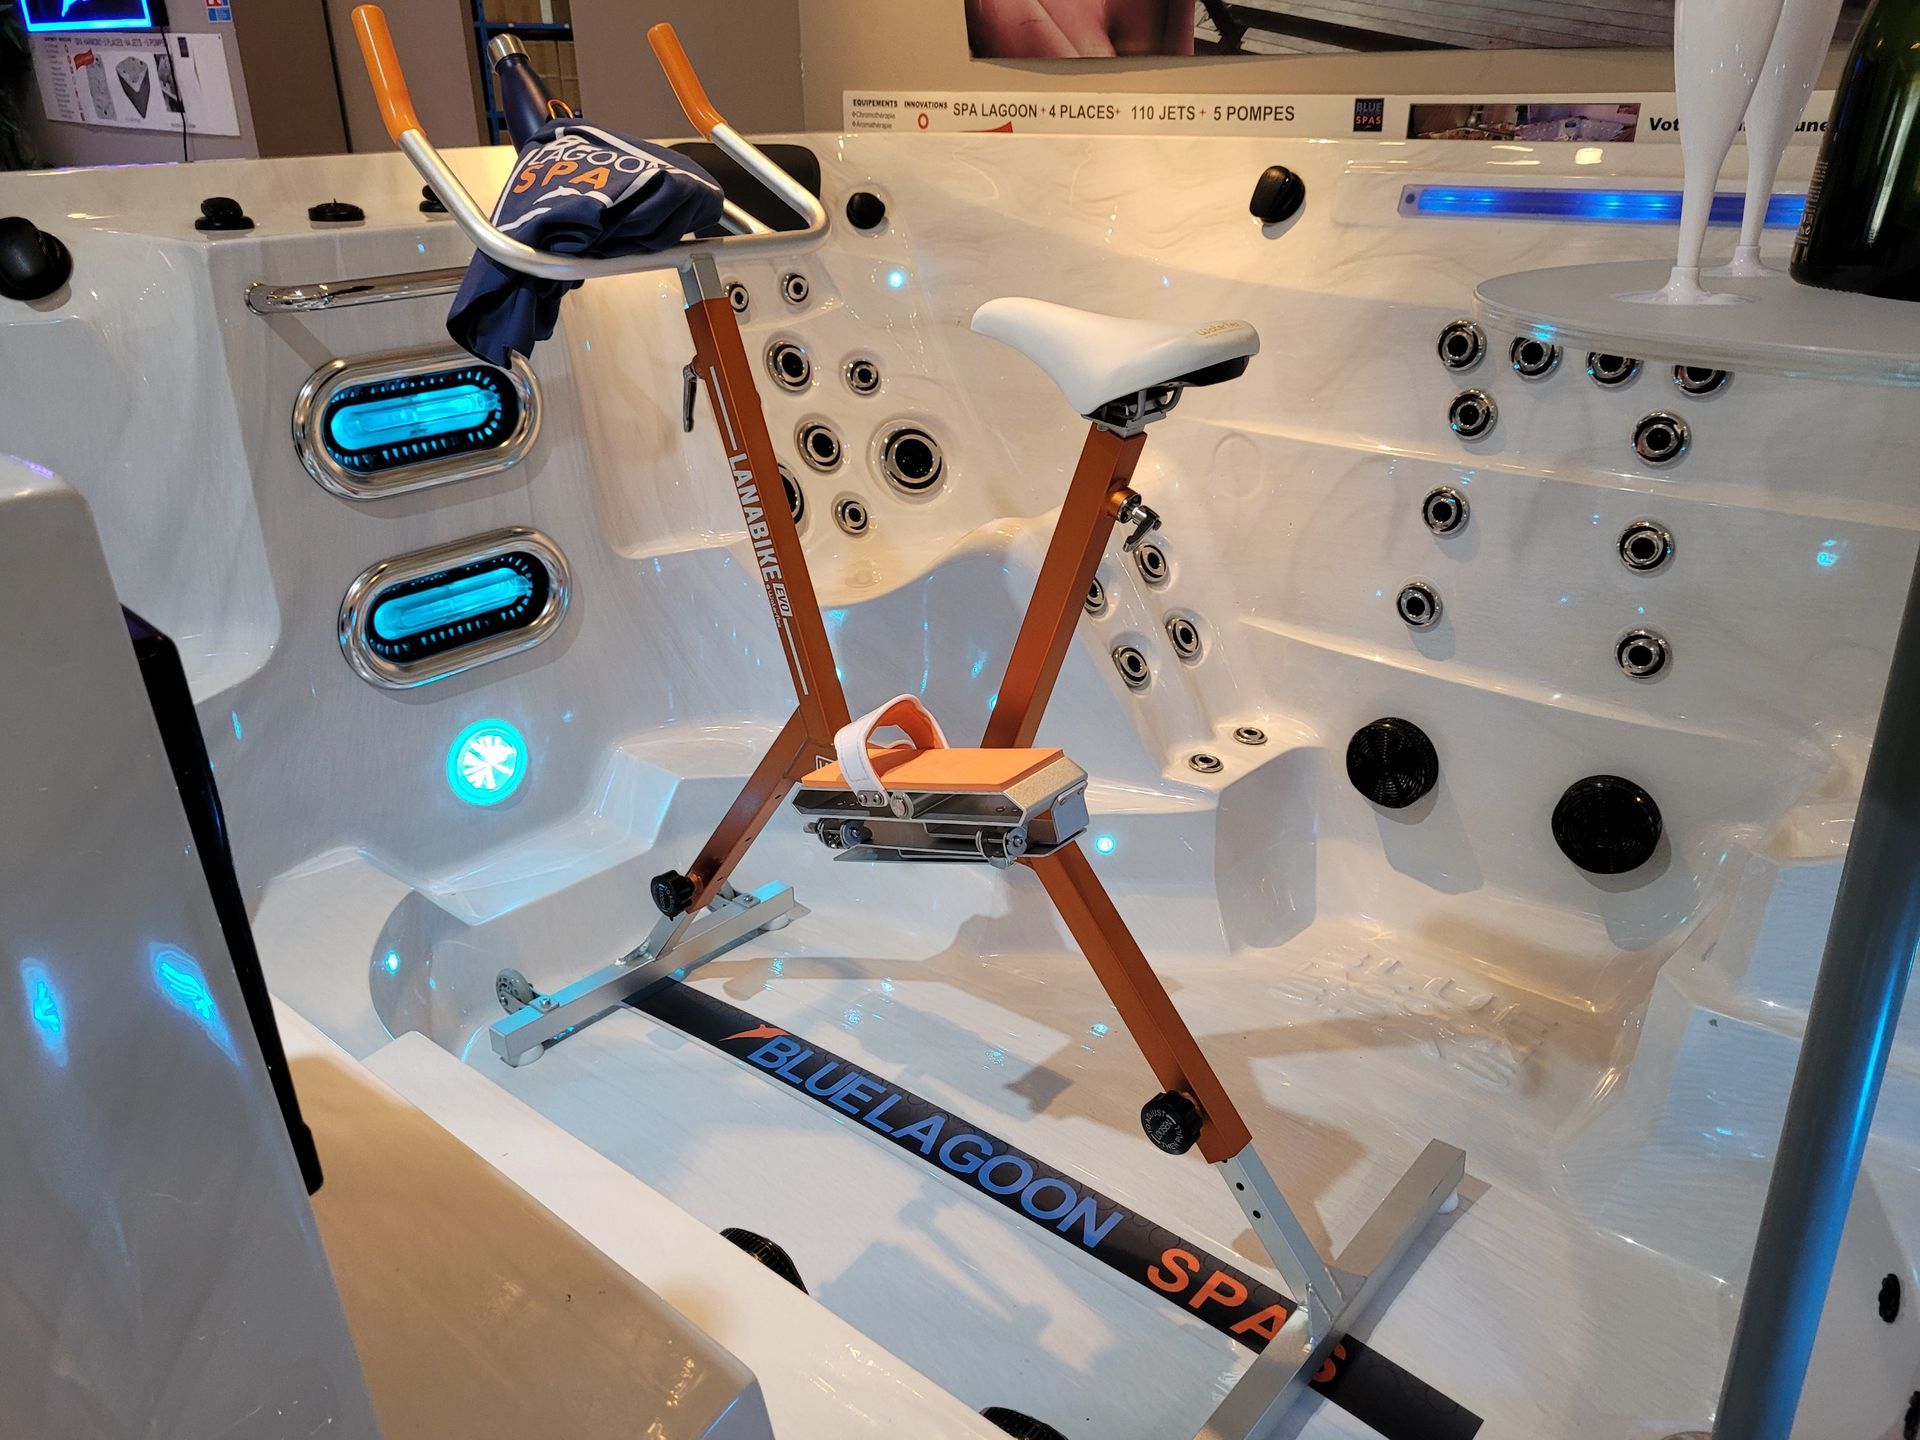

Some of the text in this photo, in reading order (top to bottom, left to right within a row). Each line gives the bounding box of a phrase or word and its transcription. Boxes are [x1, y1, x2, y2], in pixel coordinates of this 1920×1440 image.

[853, 99, 898, 108] EQUIPEMENTS
[904, 101, 948, 109] INNOVATIONS
[1356, 102, 1382, 112] BLUE
[953, 103, 978, 117] SPA
[982, 103, 1037, 118] LAGOON
[1131, 105, 1155, 120] 110
[1159, 105, 1196, 121] JETS
[1213, 106, 1222, 121] 5
[1227, 106, 1295, 121] POMPES
[1355, 115, 1381, 125] SPAS
[1650, 117, 1679, 131] Vot
[513, 161, 611, 194] SPA
[728, 453, 790, 612] LANABIKE EVO
